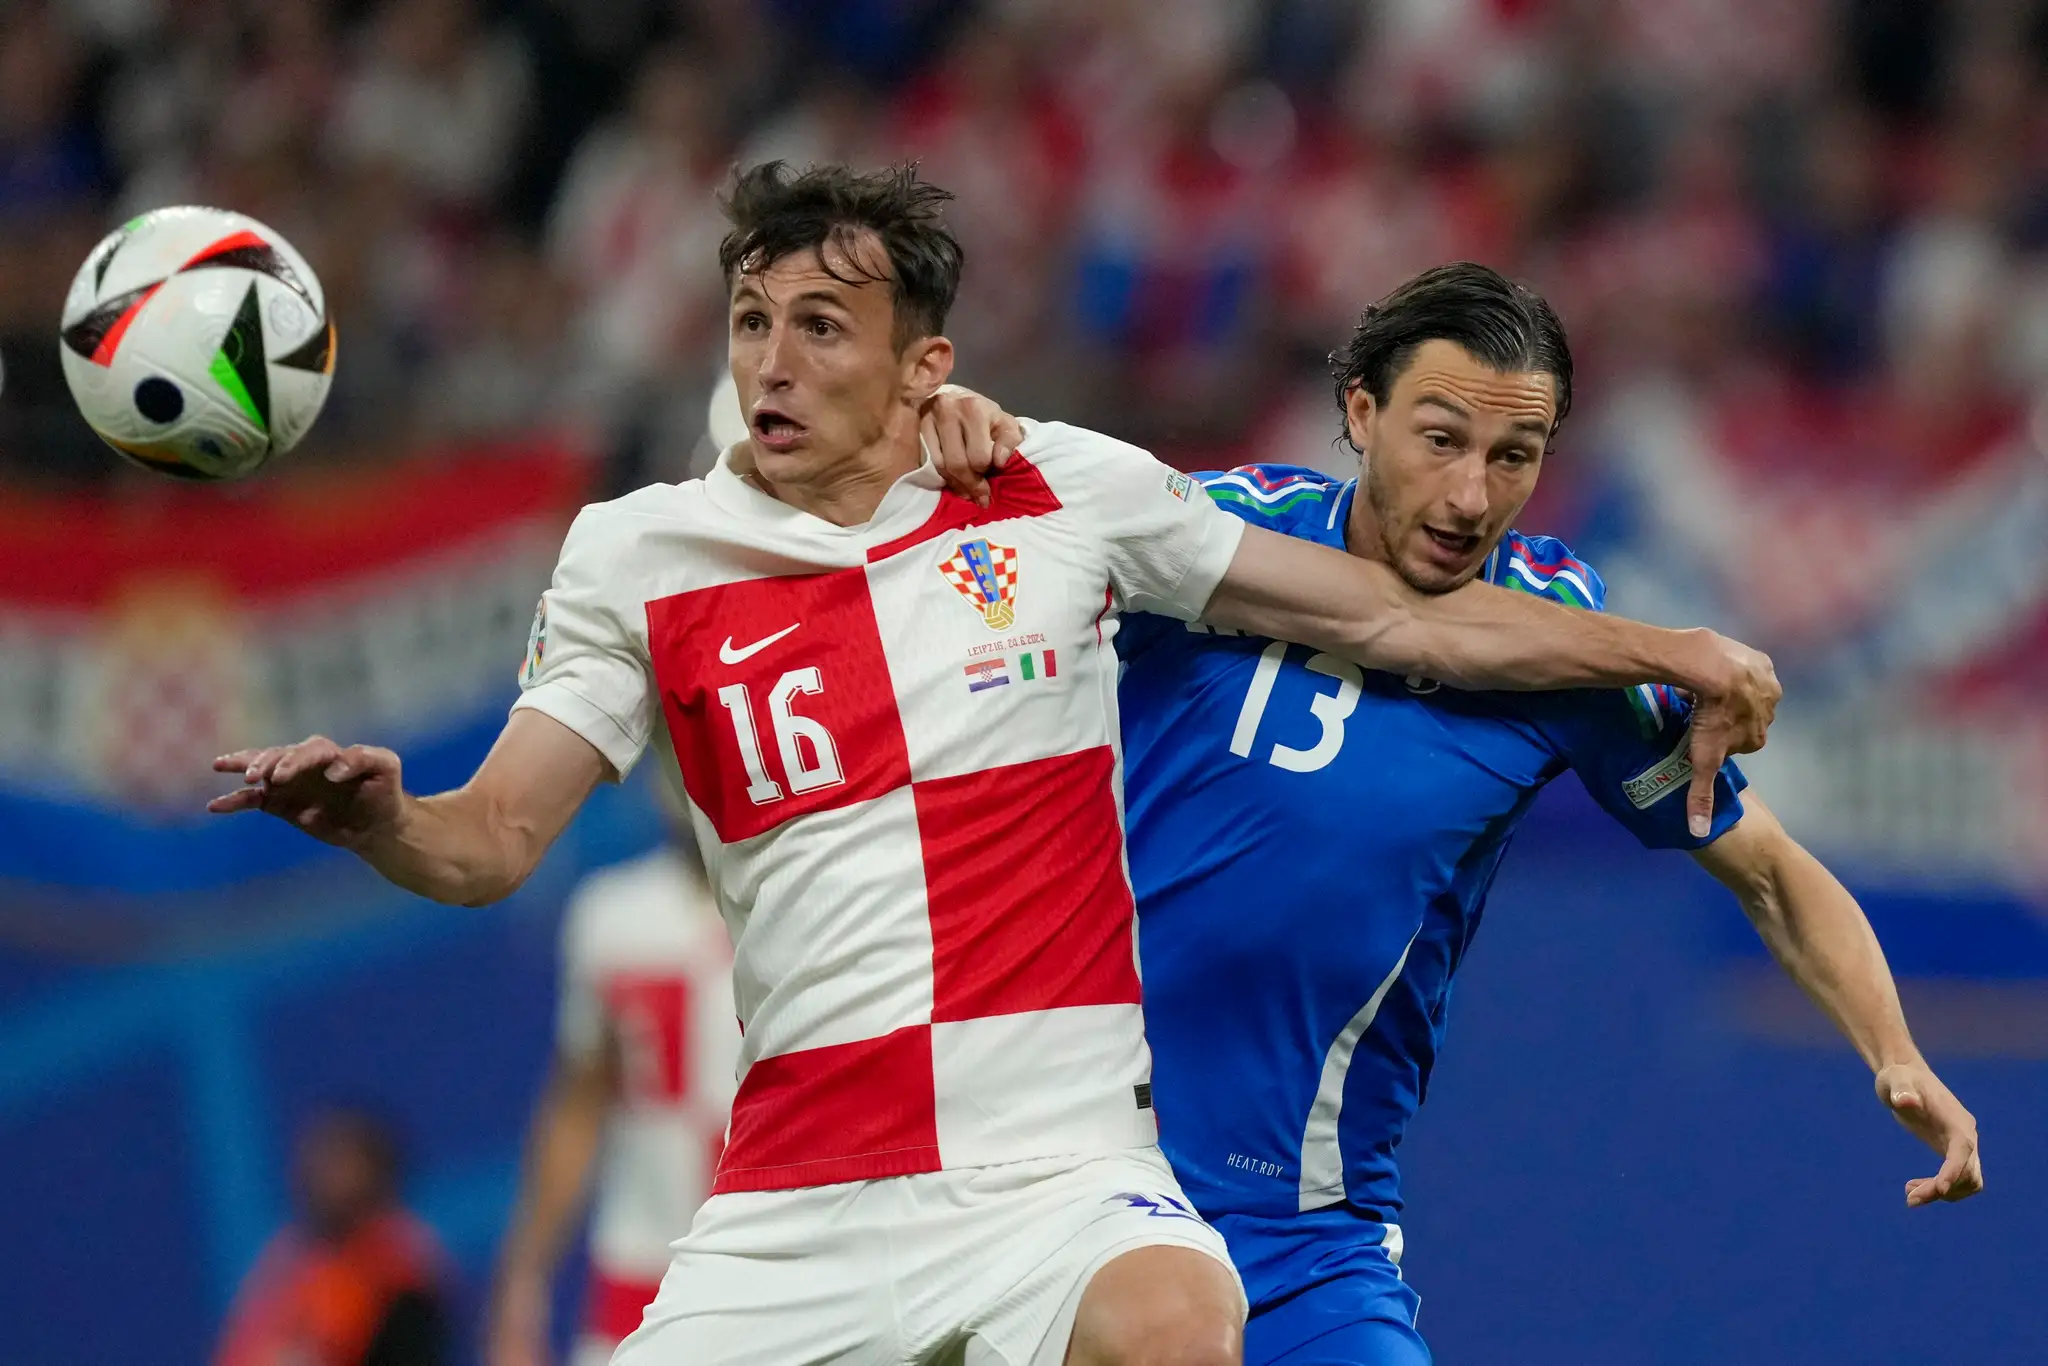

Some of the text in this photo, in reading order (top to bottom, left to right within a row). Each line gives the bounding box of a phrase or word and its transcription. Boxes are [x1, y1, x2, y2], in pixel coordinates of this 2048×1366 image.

[969, 547, 995, 593] HNS
[1229, 641, 1364, 773] 13
[717, 666, 846, 806] 16
[1627, 749, 1692, 802] FOUNDAT
[1226, 1152, 1284, 1178] HEAT.RDY
